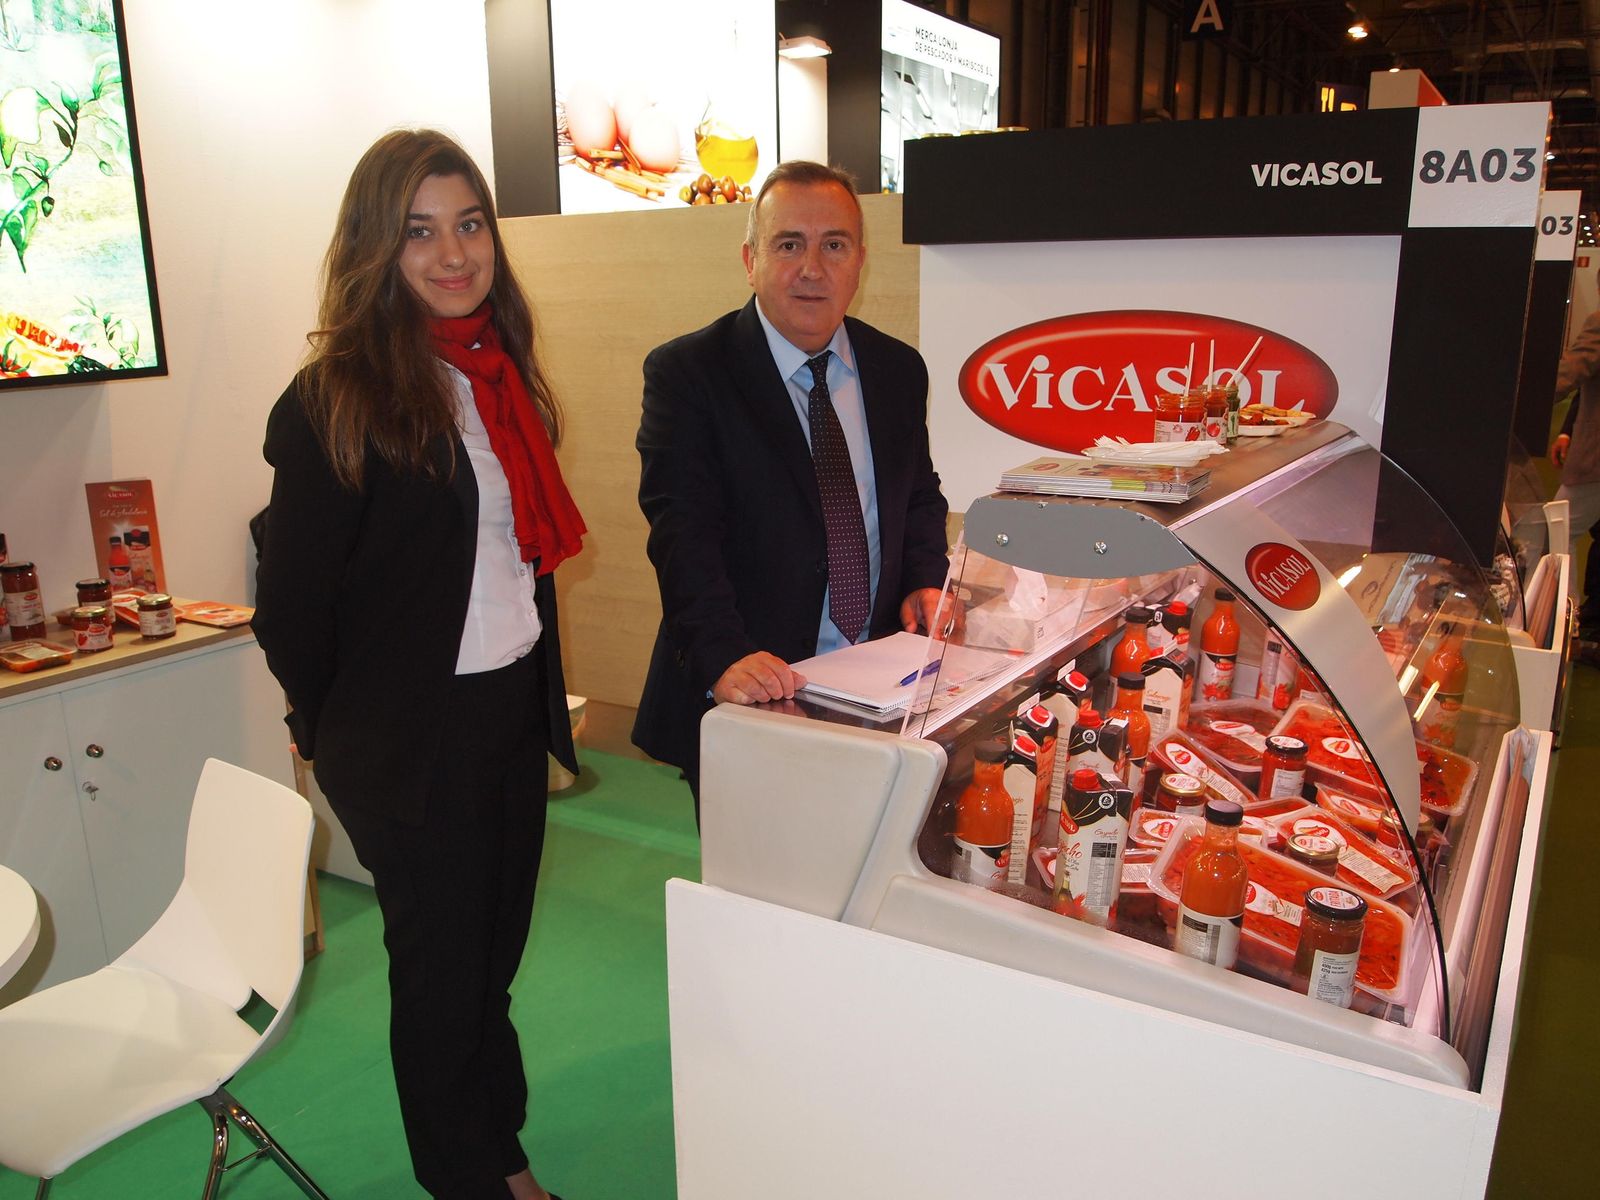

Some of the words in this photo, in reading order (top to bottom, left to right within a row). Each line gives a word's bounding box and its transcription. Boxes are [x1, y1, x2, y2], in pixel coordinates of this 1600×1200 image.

[1190, 0, 1224, 33] A
[1250, 160, 1383, 187] VICASOL
[1418, 147, 1537, 184] 8A03
